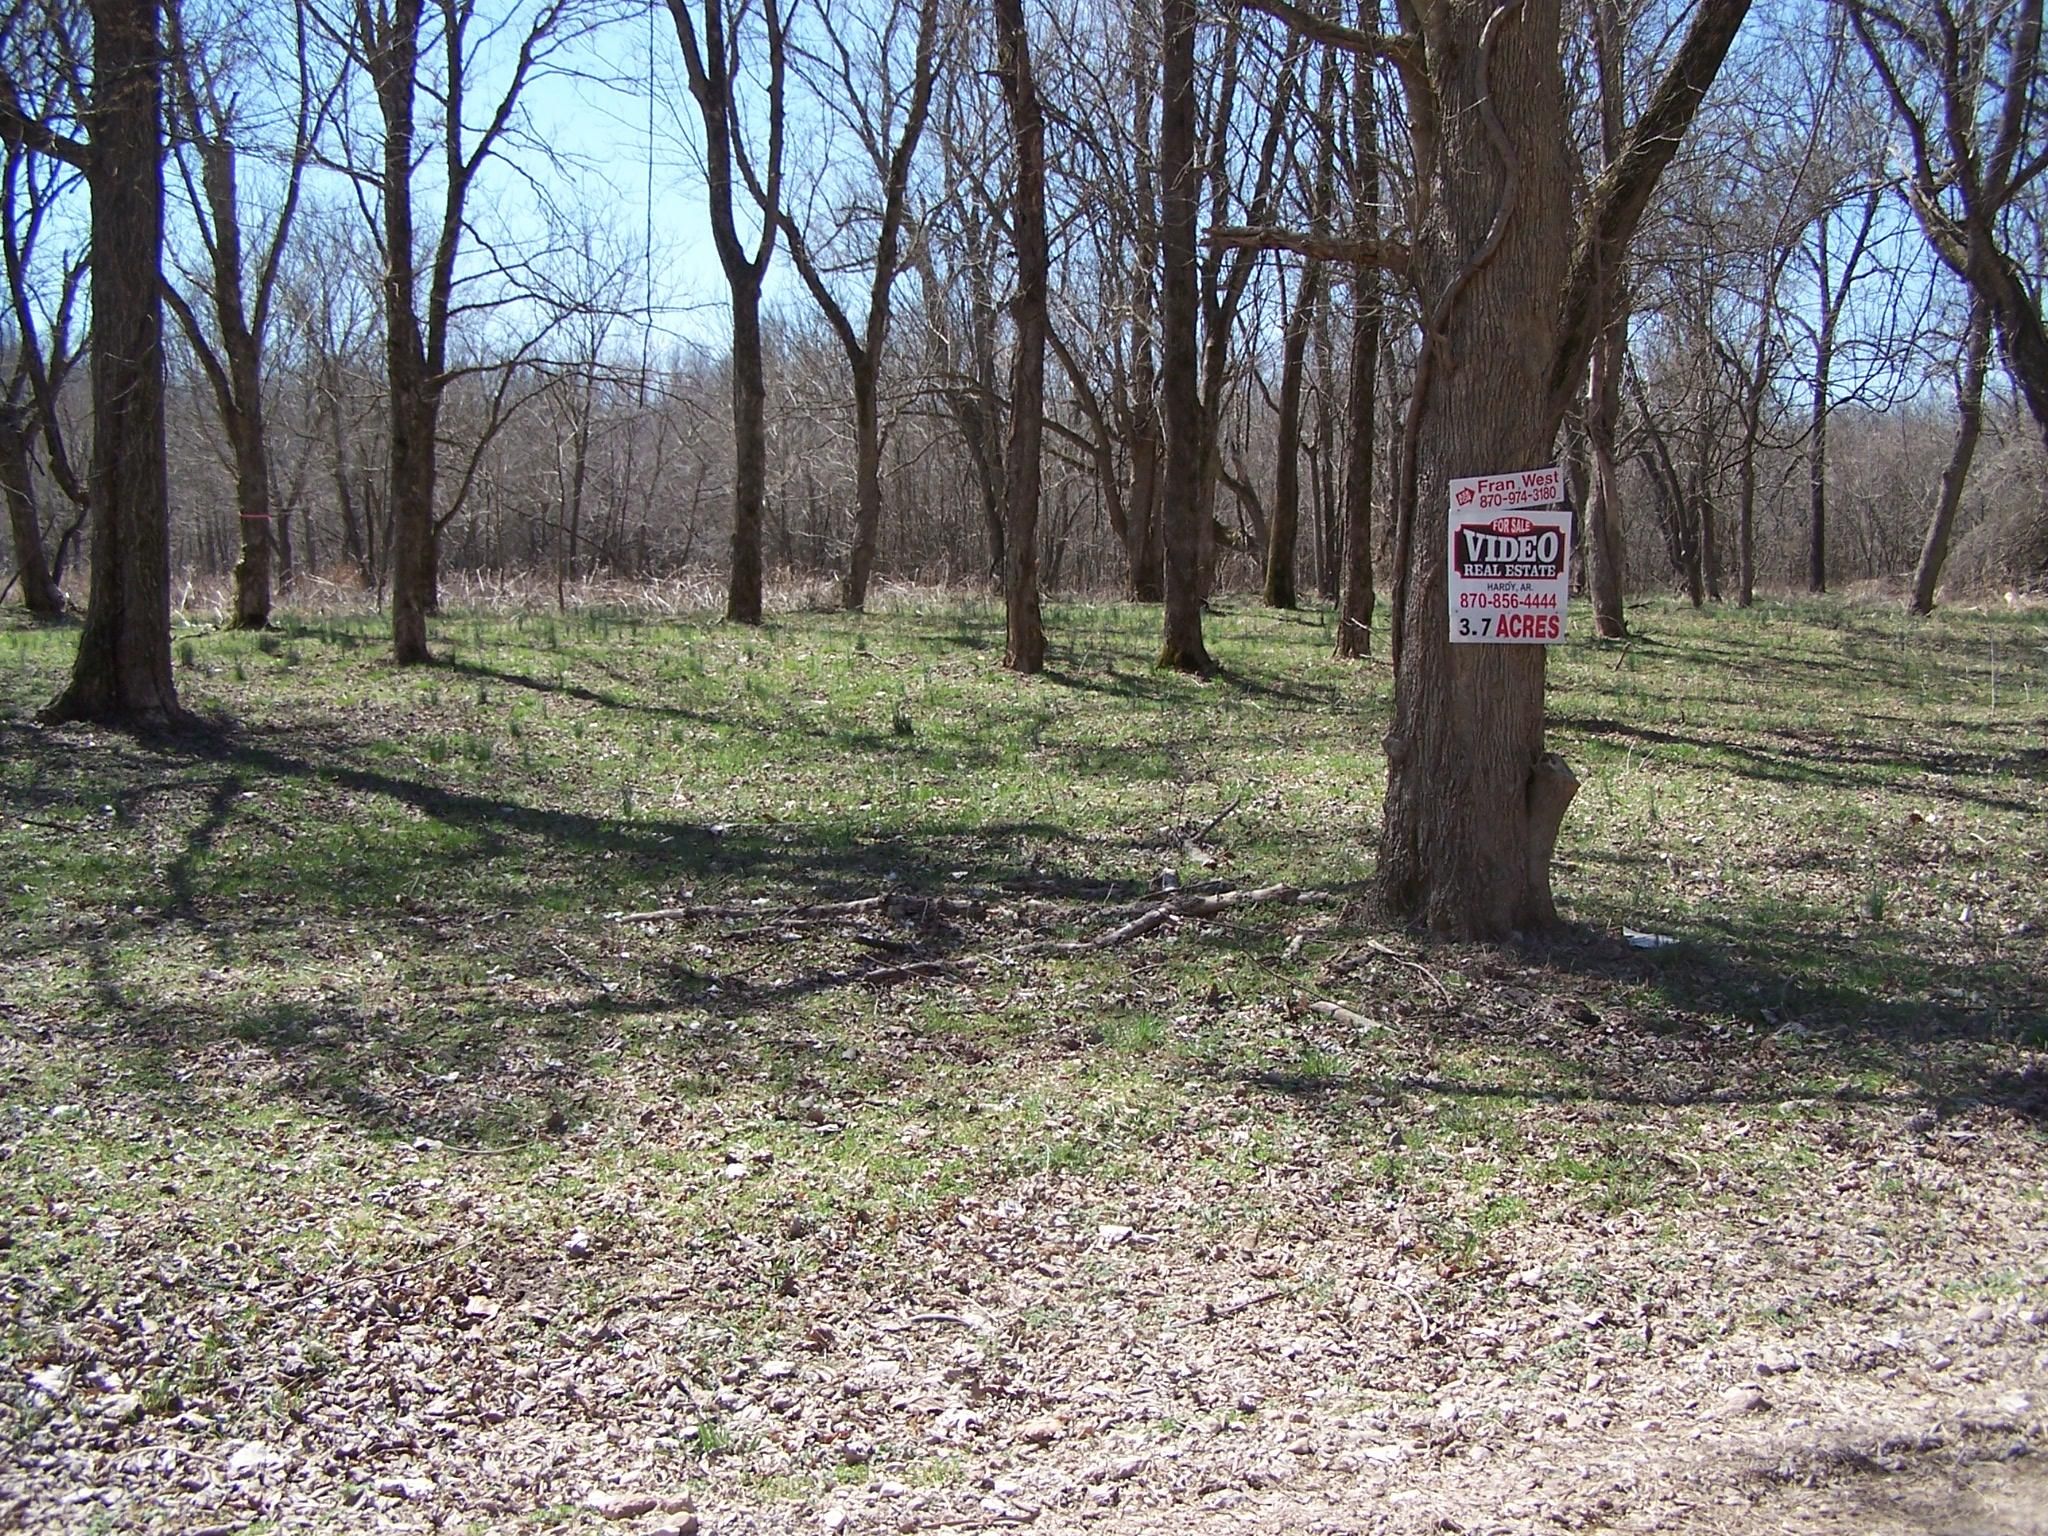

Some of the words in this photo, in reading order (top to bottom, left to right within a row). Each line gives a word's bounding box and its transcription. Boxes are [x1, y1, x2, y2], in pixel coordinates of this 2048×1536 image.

[1478, 480, 1515, 493] Fran
[1522, 471, 1559, 487] West
[1480, 486, 1556, 508] 870-974-3180
[1493, 519, 1511, 533] FOR
[1511, 519, 1530, 533] SALE
[1463, 529, 1559, 562] VIDEO
[1464, 564, 1501, 577] REAL
[1505, 564, 1556, 577] ESTATE
[1487, 583, 1519, 592] HARDY,
[1520, 583, 1534, 591] AR.
[1460, 593, 1557, 608] 870-856-4444
[1459, 618, 1492, 637] 3.7
[1496, 614, 1560, 639] ACRES
